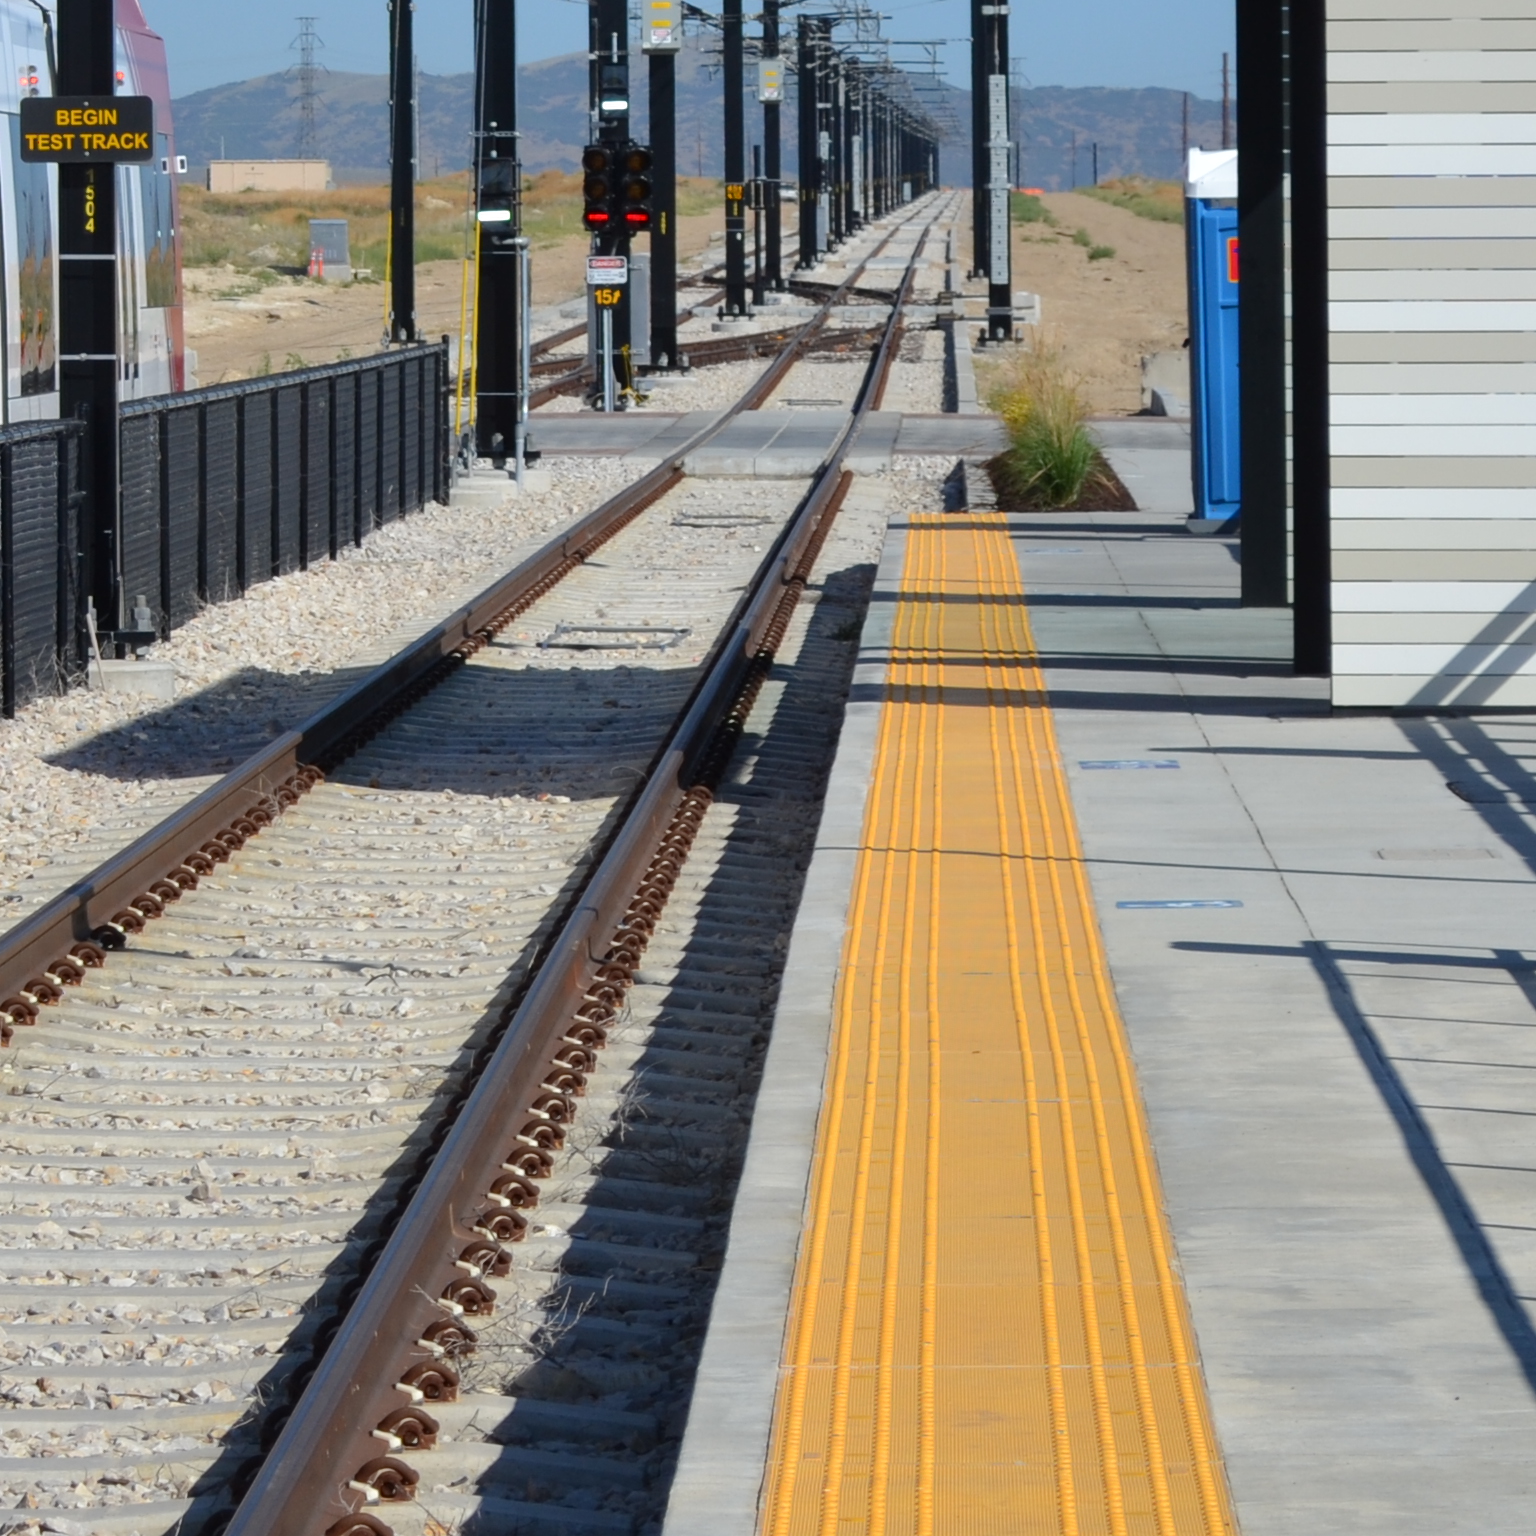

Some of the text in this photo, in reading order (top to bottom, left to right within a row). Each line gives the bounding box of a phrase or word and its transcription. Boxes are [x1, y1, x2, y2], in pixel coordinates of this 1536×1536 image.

[56, 109, 117, 125] BEGIN
[25, 133, 148, 150] TEST TRACK
[594, 289, 613, 305] 15
